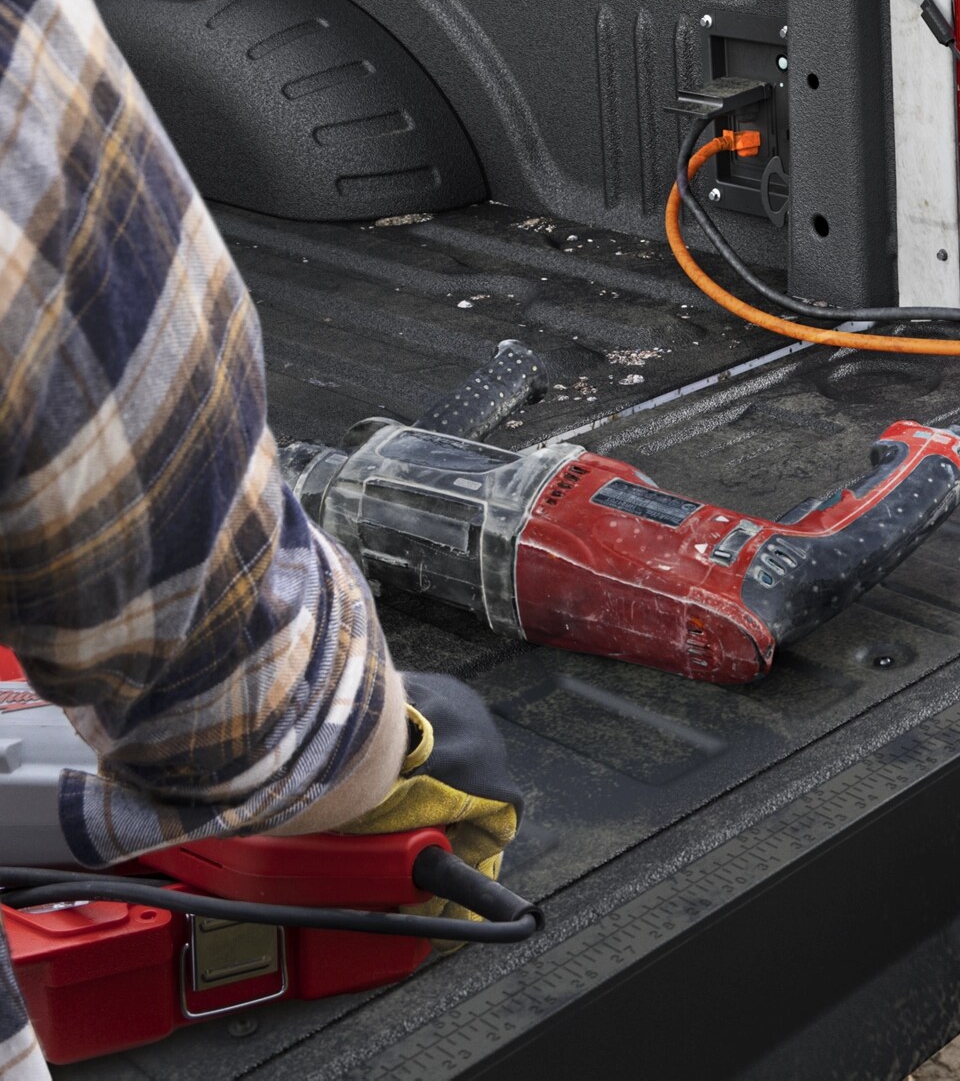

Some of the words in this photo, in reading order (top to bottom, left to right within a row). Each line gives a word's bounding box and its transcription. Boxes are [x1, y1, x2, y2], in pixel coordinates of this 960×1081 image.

[441, 1049, 472, 1070] 23
[486, 1022, 516, 1042] 24
[529, 995, 558, 1014] 25
[570, 969, 599, 988] 26
[610, 945, 636, 963] 27
[649, 921, 676, 939] 28
[721, 876, 748, 893] 30
[757, 856, 781, 871] 31
[790, 834, 816, 850] 32
[823, 814, 847, 829] 33
[854, 794, 879, 809] 34
[885, 775, 908, 790] 35
